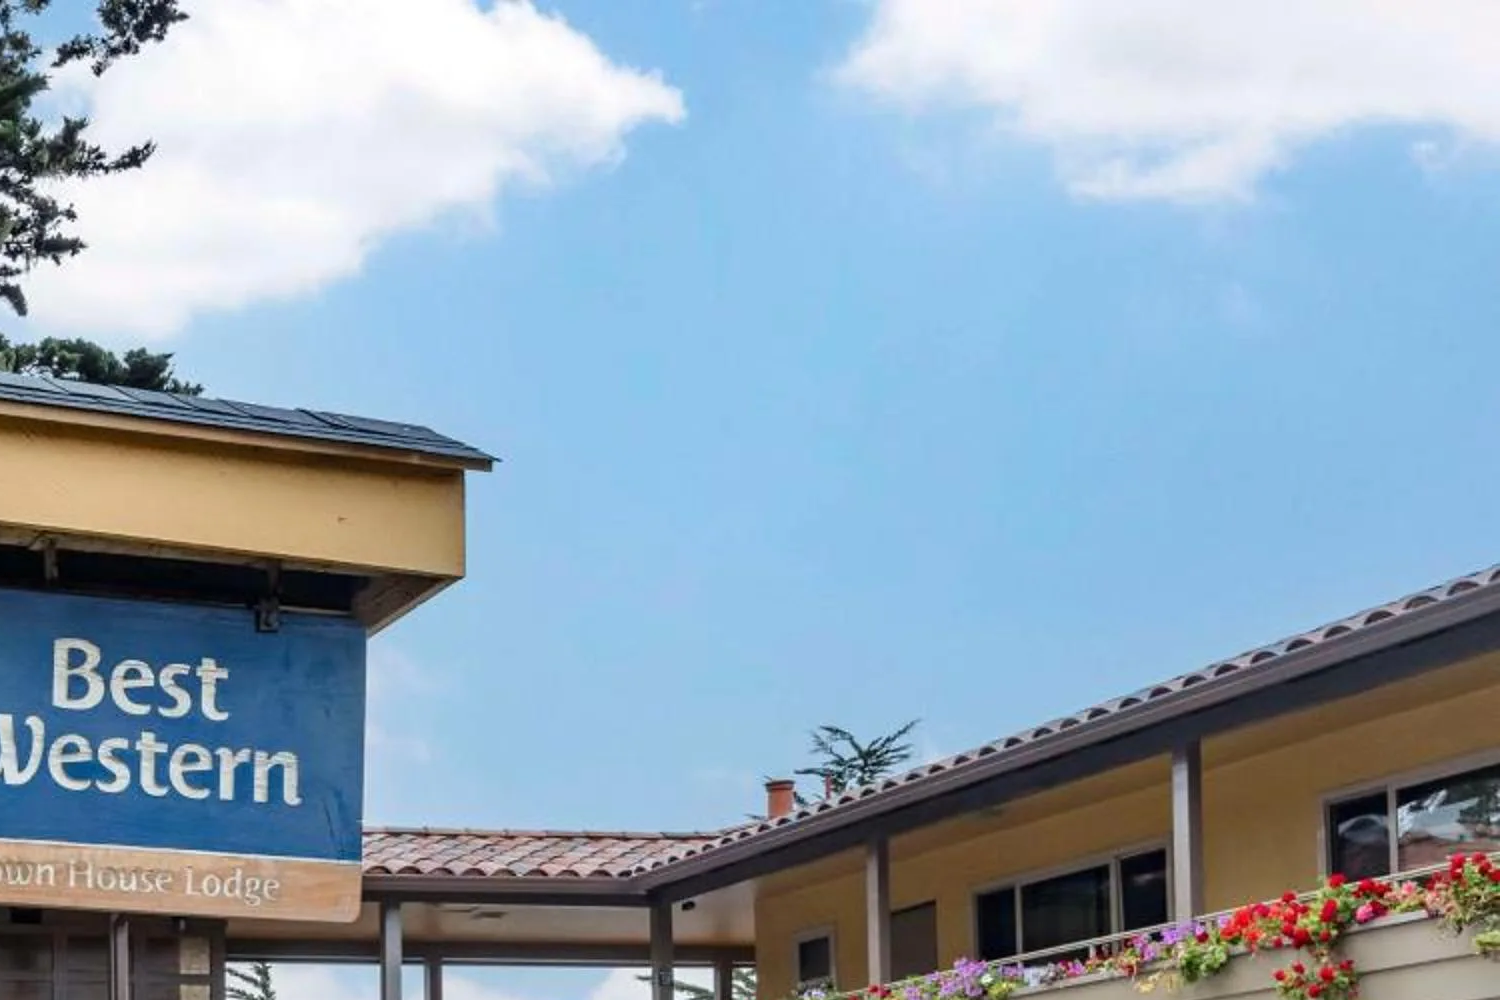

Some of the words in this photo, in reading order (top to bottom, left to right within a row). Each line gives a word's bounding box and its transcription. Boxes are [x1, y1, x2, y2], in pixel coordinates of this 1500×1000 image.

[51, 637, 230, 721] Best
[69, 861, 173, 894] House
[185, 866, 281, 906] Lodge
